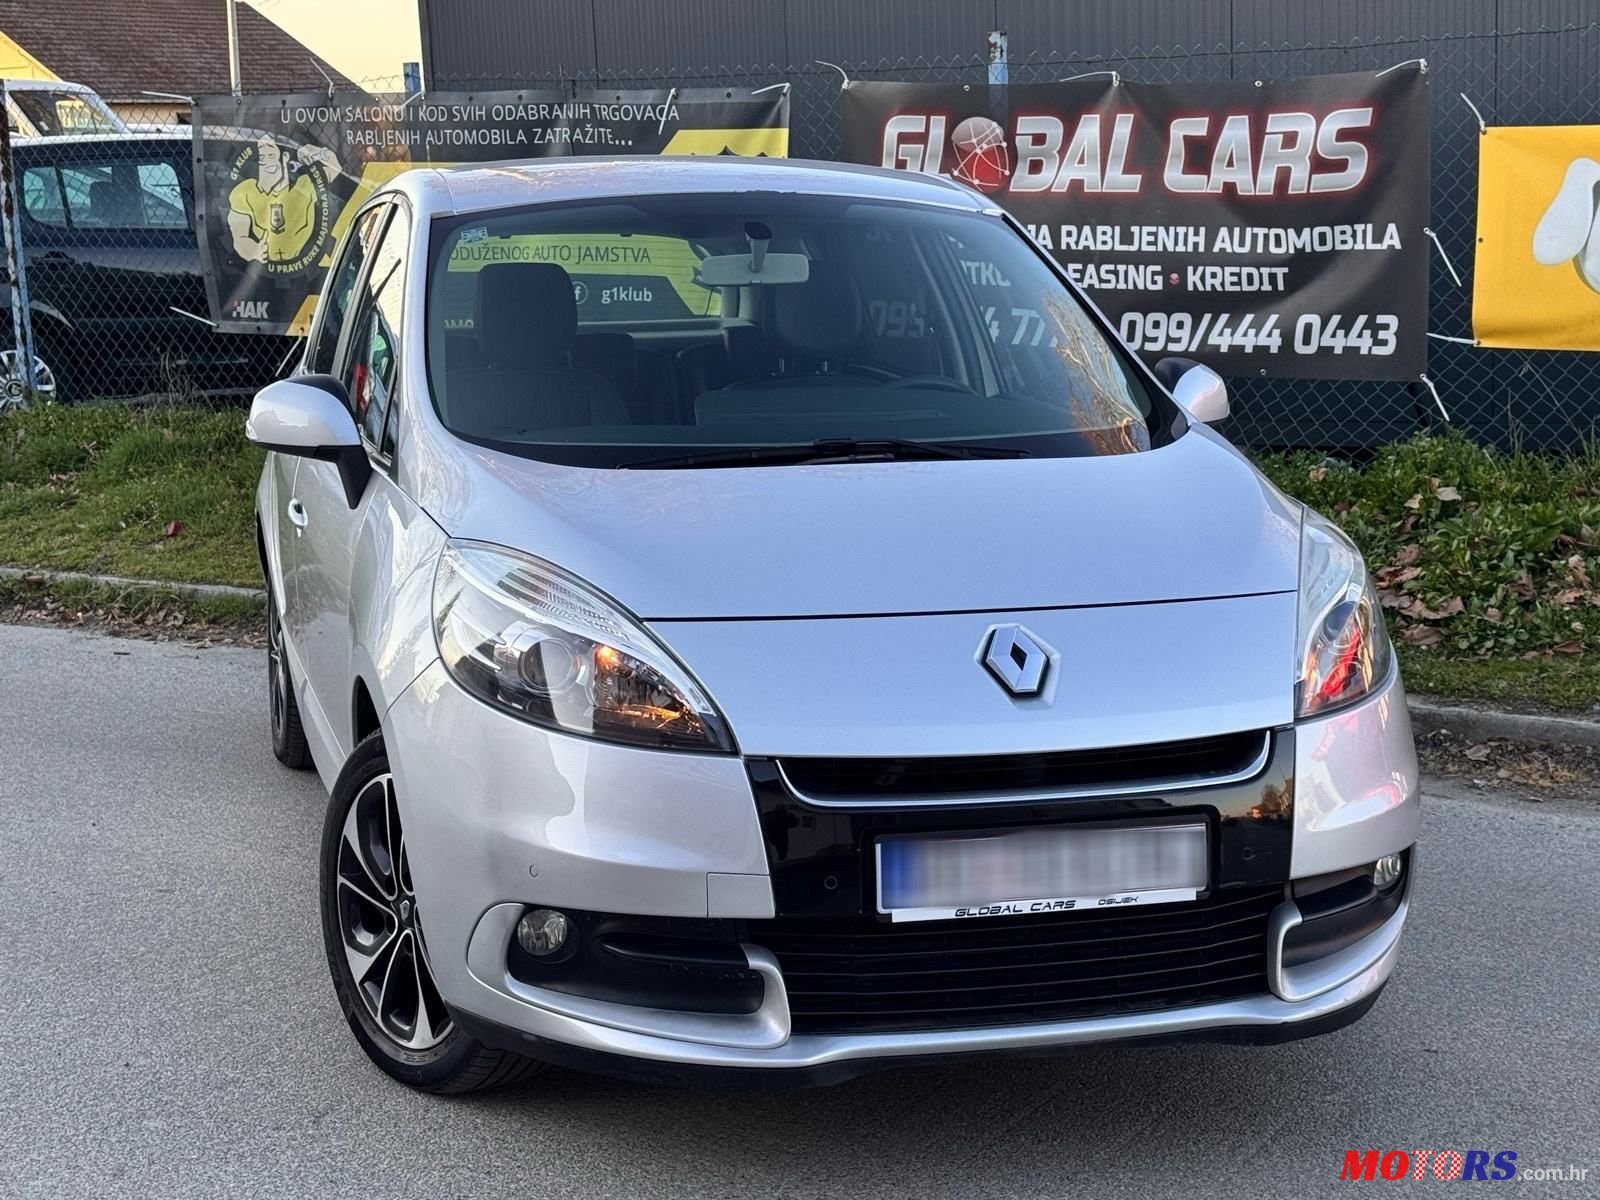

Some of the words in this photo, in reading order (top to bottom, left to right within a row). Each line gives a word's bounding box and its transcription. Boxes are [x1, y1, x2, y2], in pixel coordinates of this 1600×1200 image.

[281, 108, 291, 123] U
[295, 107, 342, 123] OVOM
[345, 106, 404, 122] SALONU
[409, 107, 413, 122] I
[418, 106, 448, 122] KOD
[452, 105, 486, 121] SVIH
[491, 104, 590, 121] ODABRANIH
[593, 104, 680, 121] TRGOVACA
[346, 130, 420, 148] RABLJENIH
[426, 129, 528, 145] AUTOMOBILA
[236, 147, 253, 169] KLUB
[882, 113, 1142, 193] GLOBAL
[1163, 107, 1374, 196] CARS
[268, 262, 275, 273] U
[277, 260, 304, 273] PRAVE
[302, 248, 320, 265] RUKE
[316, 195, 329, 247] MAJSTORA
[1061, 225, 1206, 253] RABLJENIH
[1213, 223, 1402, 254] AUTOMOBILA
[532, 245, 571, 261] AUTO
[576, 246, 651, 264] JAMSTVA
[1066, 263, 1163, 290] EASING
[1187, 266, 1289, 292] KREDIT
[601, 286, 653, 304] g1klub
[1119, 311, 1282, 353] 099/444
[1293, 313, 1399, 356] 0443
[954, 904, 1024, 918] GLOBAL
[1030, 900, 1077, 912] CARS
